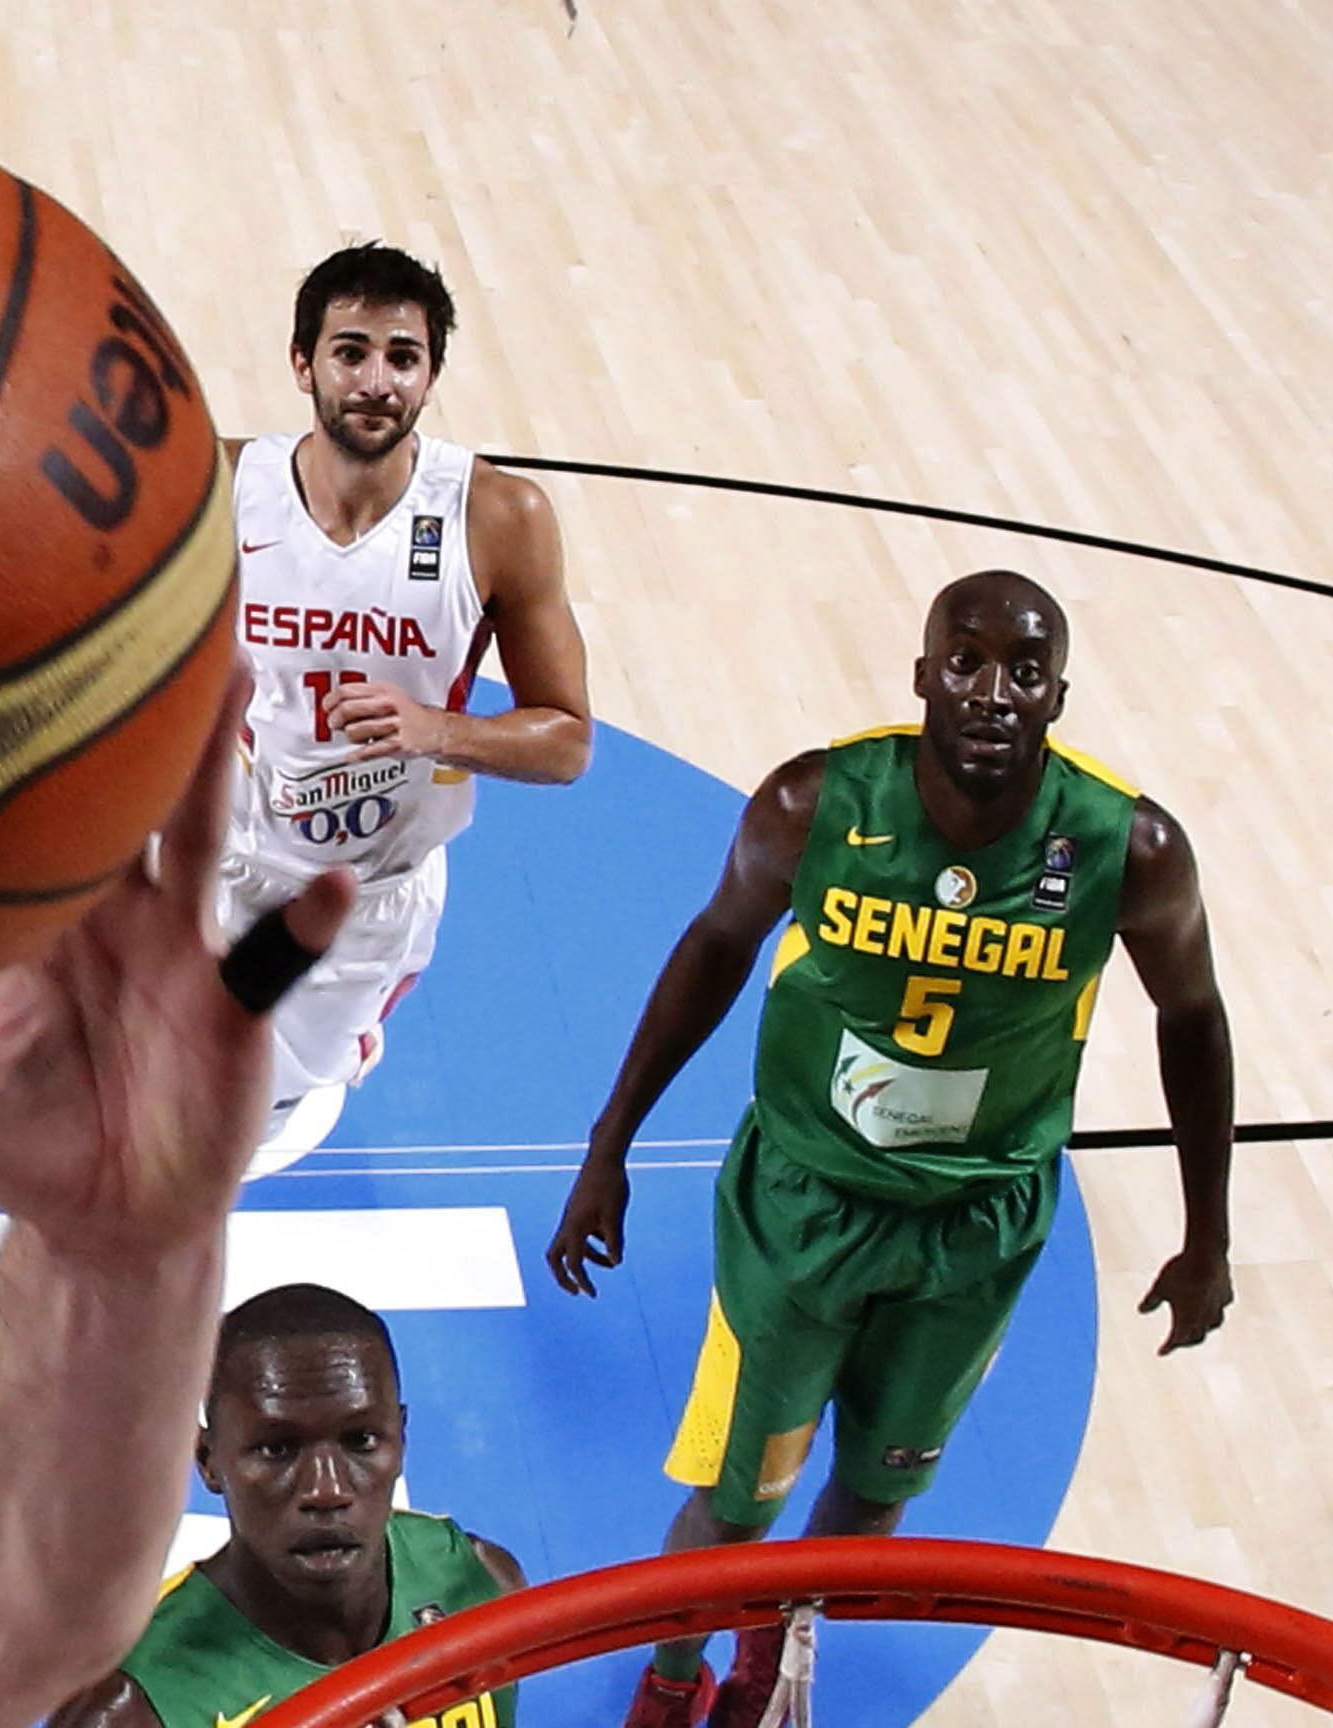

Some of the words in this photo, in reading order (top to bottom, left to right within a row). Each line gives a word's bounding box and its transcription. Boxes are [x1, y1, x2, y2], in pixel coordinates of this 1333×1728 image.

[41, 275, 192, 531] ten
[244, 603, 437, 659] ESPAÑA
[303, 670, 368, 743] 1
[272, 783, 323, 810] San
[321, 760, 407, 800] Miguel
[818, 886, 1069, 981] SENEGAL
[891, 975, 962, 1057] 5
